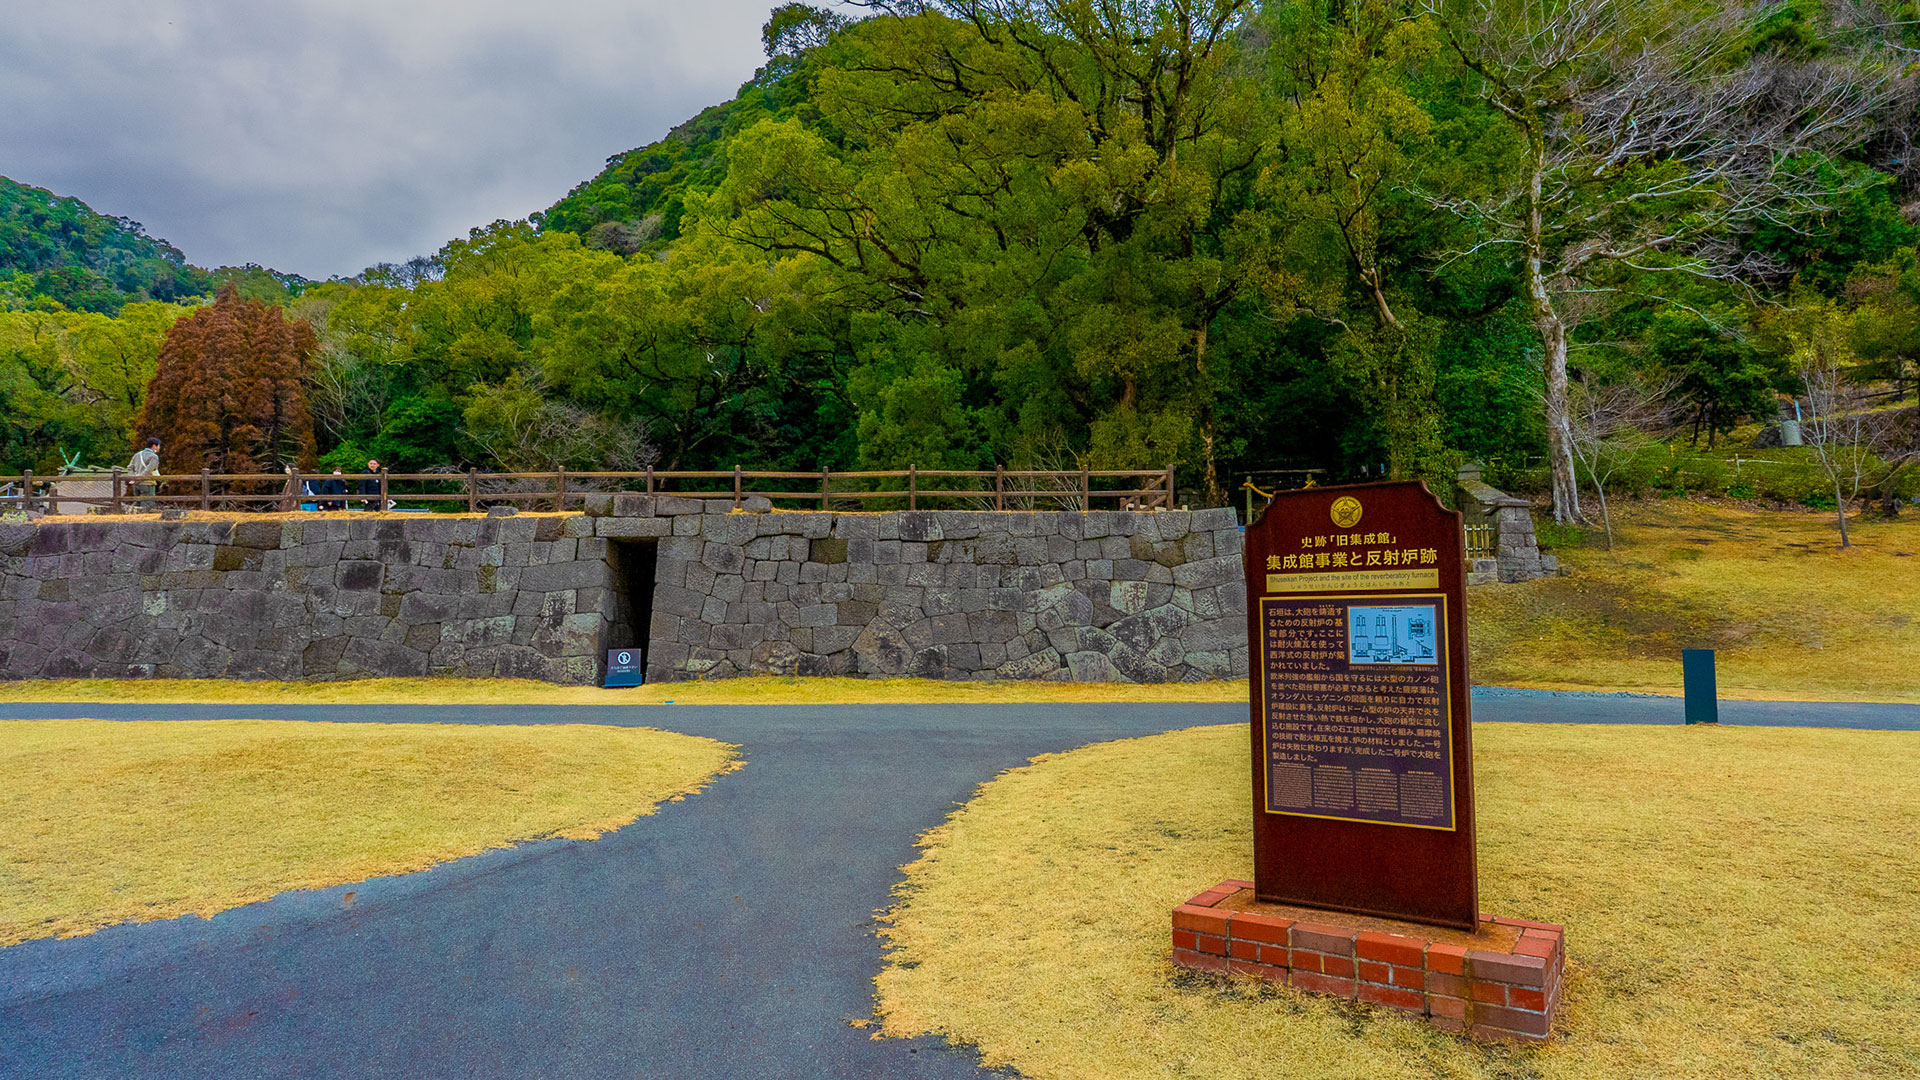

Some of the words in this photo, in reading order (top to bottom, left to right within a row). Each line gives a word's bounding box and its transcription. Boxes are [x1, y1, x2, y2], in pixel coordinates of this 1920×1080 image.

[1301, 532, 1397, 549] 史跡「旧集成館」
[1266, 548, 1438, 571] 集成館事業と反射炉跡
[1299, 575, 1318, 583] Project
[1371, 572, 1410, 580] reverberatory
[1270, 662, 1330, 671] かれていました。
[1272, 752, 1318, 762] 製造しました。
